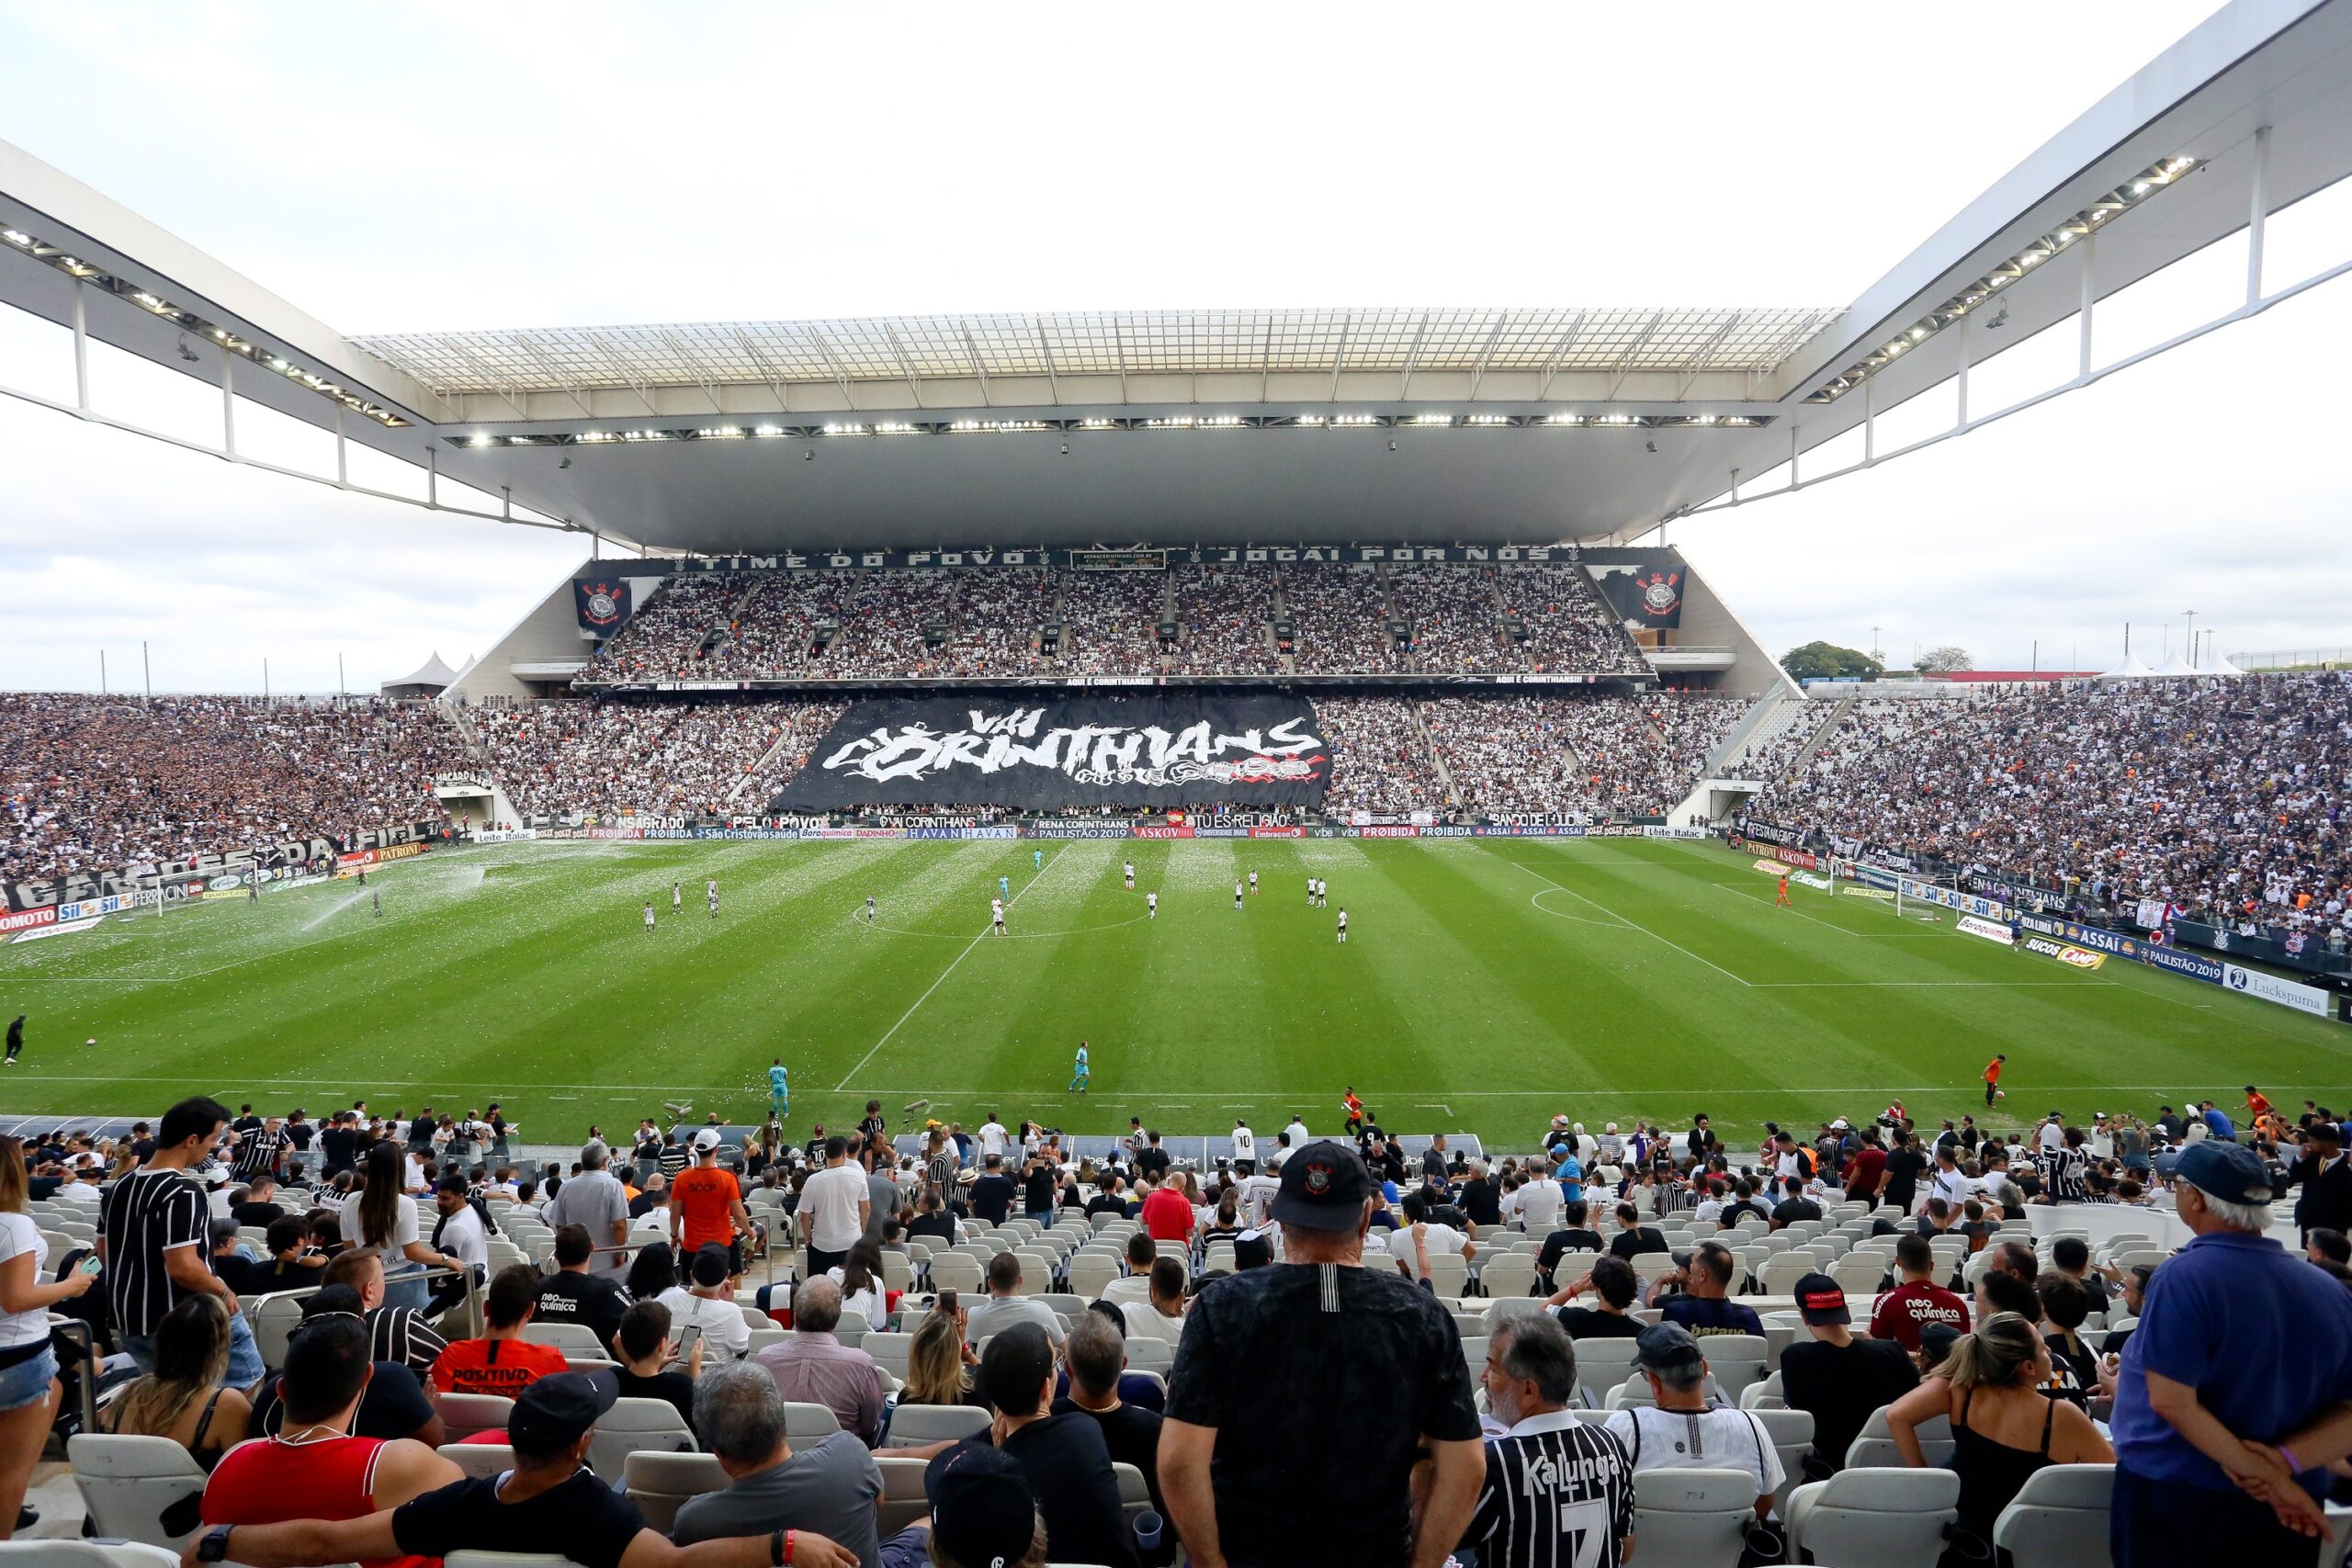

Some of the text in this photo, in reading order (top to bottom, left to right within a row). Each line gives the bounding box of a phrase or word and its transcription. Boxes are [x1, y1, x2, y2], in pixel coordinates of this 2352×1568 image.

[699, 552, 1024, 570] TIME DO POVO
[1220, 549, 1339, 562] JOGAI
[1362, 548, 1445, 561] POR
[1067, 678, 1086, 686] AQUI
[1087, 676, 1092, 686] É
[1515, 675, 1521, 683] É
[656, 682, 674, 691] AQUI
[675, 682, 681, 691] É
[968, 706, 1046, 738] VAI
[732, 817, 820, 829] PELO POVO
[1032, 818, 1129, 829] RENA CORINTHIANS
[1531, 814, 1544, 826] DE
[356, 823, 426, 849] FIEL
[480, 831, 530, 842] Leite Italac
[706, 828, 723, 839] São
[724, 828, 768, 840] Cristóvão
[856, 829, 895, 838] DADINHO
[910, 829, 960, 839] HAVAN
[965, 829, 1016, 839] HAVAN
[1039, 828, 1127, 839] PAULISTÃO 2019
[1139, 828, 1178, 839] ASKOV
[1585, 825, 1604, 836] DOLLY
[1604, 825, 1623, 836] DOLLY
[1623, 825, 1644, 836] DOLLY
[1649, 828, 1700, 839] Leite Italac
[379, 843, 419, 861] PATRONI
[1747, 842, 1777, 860] PATRONI
[337, 857, 365, 868] mbracon
[1779, 850, 1804, 866] ASKOV
[1846, 887, 1894, 898] quartzolit
[1901, 879, 1913, 896] Sil
[135, 883, 189, 906] FERRACINI
[1925, 886, 1938, 902] Sil
[1948, 892, 1962, 908] Sil
[103, 896, 119, 911] Sil
[1974, 899, 1990, 916] Sil
[61, 903, 81, 919] Sil
[2025, 937, 2098, 964] SUCOS CAMP
[2150, 951, 2222, 979] PAULISTÃO 2019
[2254, 979, 2321, 1010] Luckspuma
[1238, 1135, 1250, 1147] 10
[1367, 1132, 1374, 1145] 9
[896, 1153, 921, 1164] Ube
[688, 1183, 717, 1193] SCCP
[541, 1292, 559, 1303] neo
[1905, 1298, 1933, 1309] neo
[540, 1301, 577, 1313] química
[1871, 1291, 1896, 1319] bozzano
[1909, 1305, 1961, 1322] química
[453, 1368, 529, 1382] POSITIVO
[1521, 1450, 1621, 1496] Kalunga
[1560, 1496, 1610, 1568] 7
